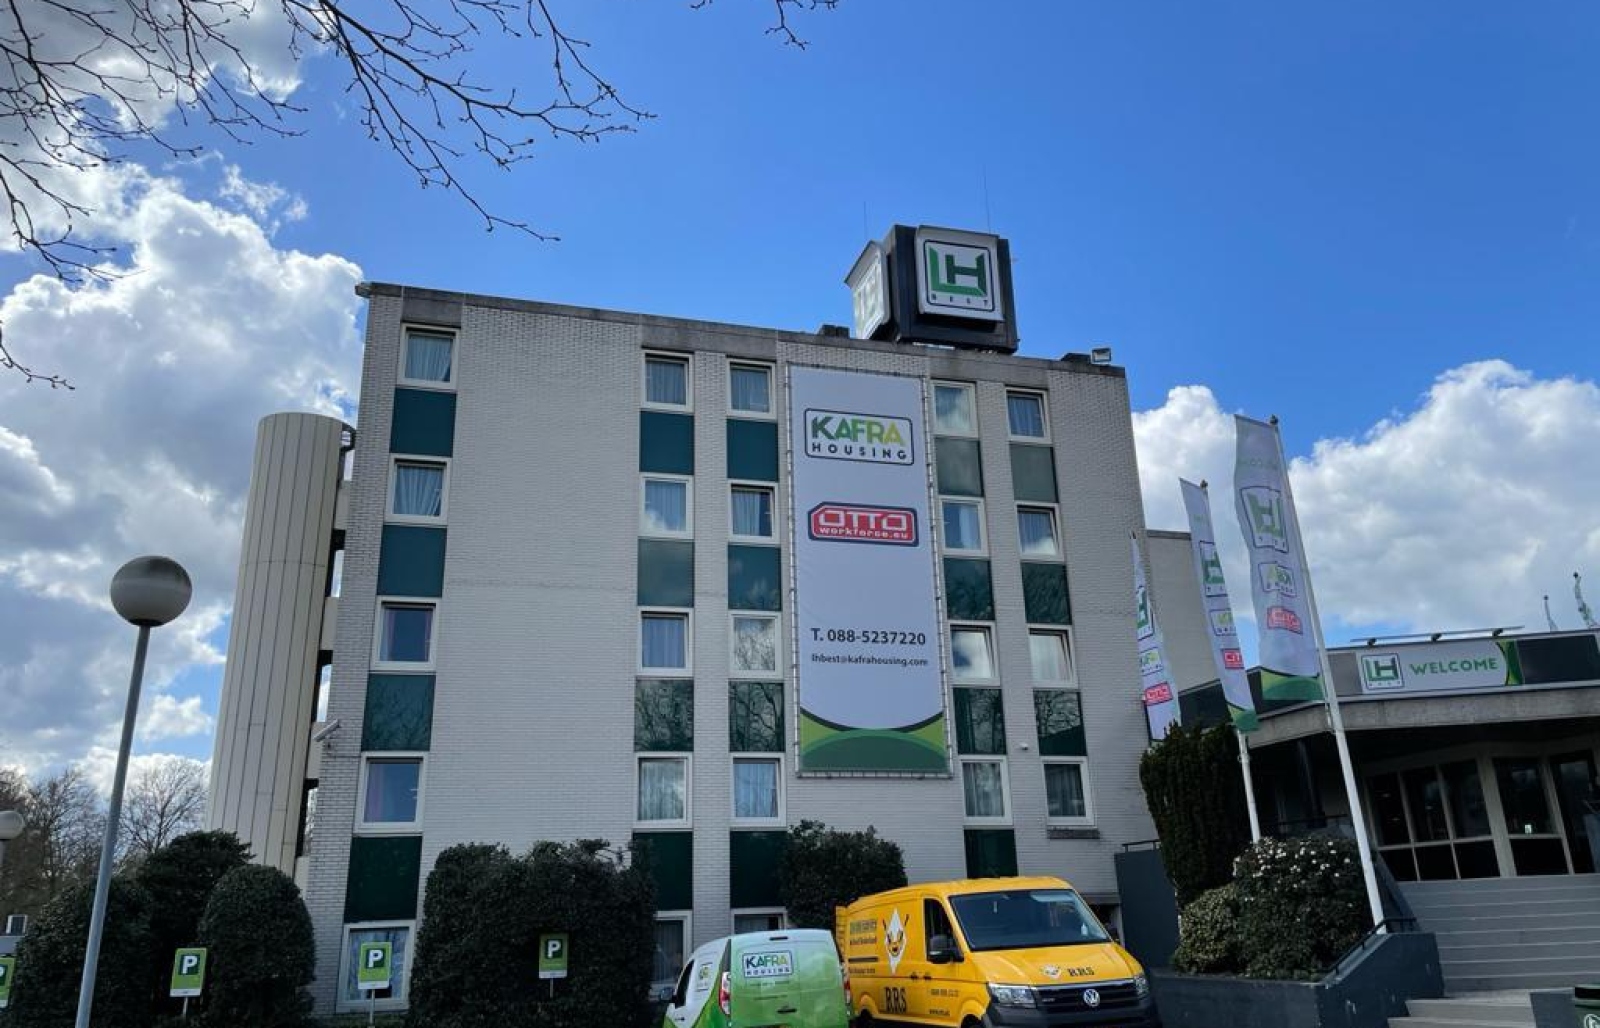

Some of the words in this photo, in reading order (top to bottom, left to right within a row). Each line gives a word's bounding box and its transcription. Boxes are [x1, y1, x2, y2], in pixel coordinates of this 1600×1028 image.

[930, 246, 988, 297] LH
[811, 415, 906, 446] KAFRA
[811, 442, 908, 460] HOUSING
[818, 510, 907, 531] OTTO
[818, 527, 909, 539] workforce.eu
[810, 627, 824, 641] T.
[827, 629, 926, 645] 088-5237220
[1365, 656, 1399, 682] LH
[1409, 657, 1498, 675] WELCOME
[368, 949, 384, 968] P
[547, 940, 561, 959] P
[182, 955, 198, 974] P
[746, 954, 788, 969] KAFRA
